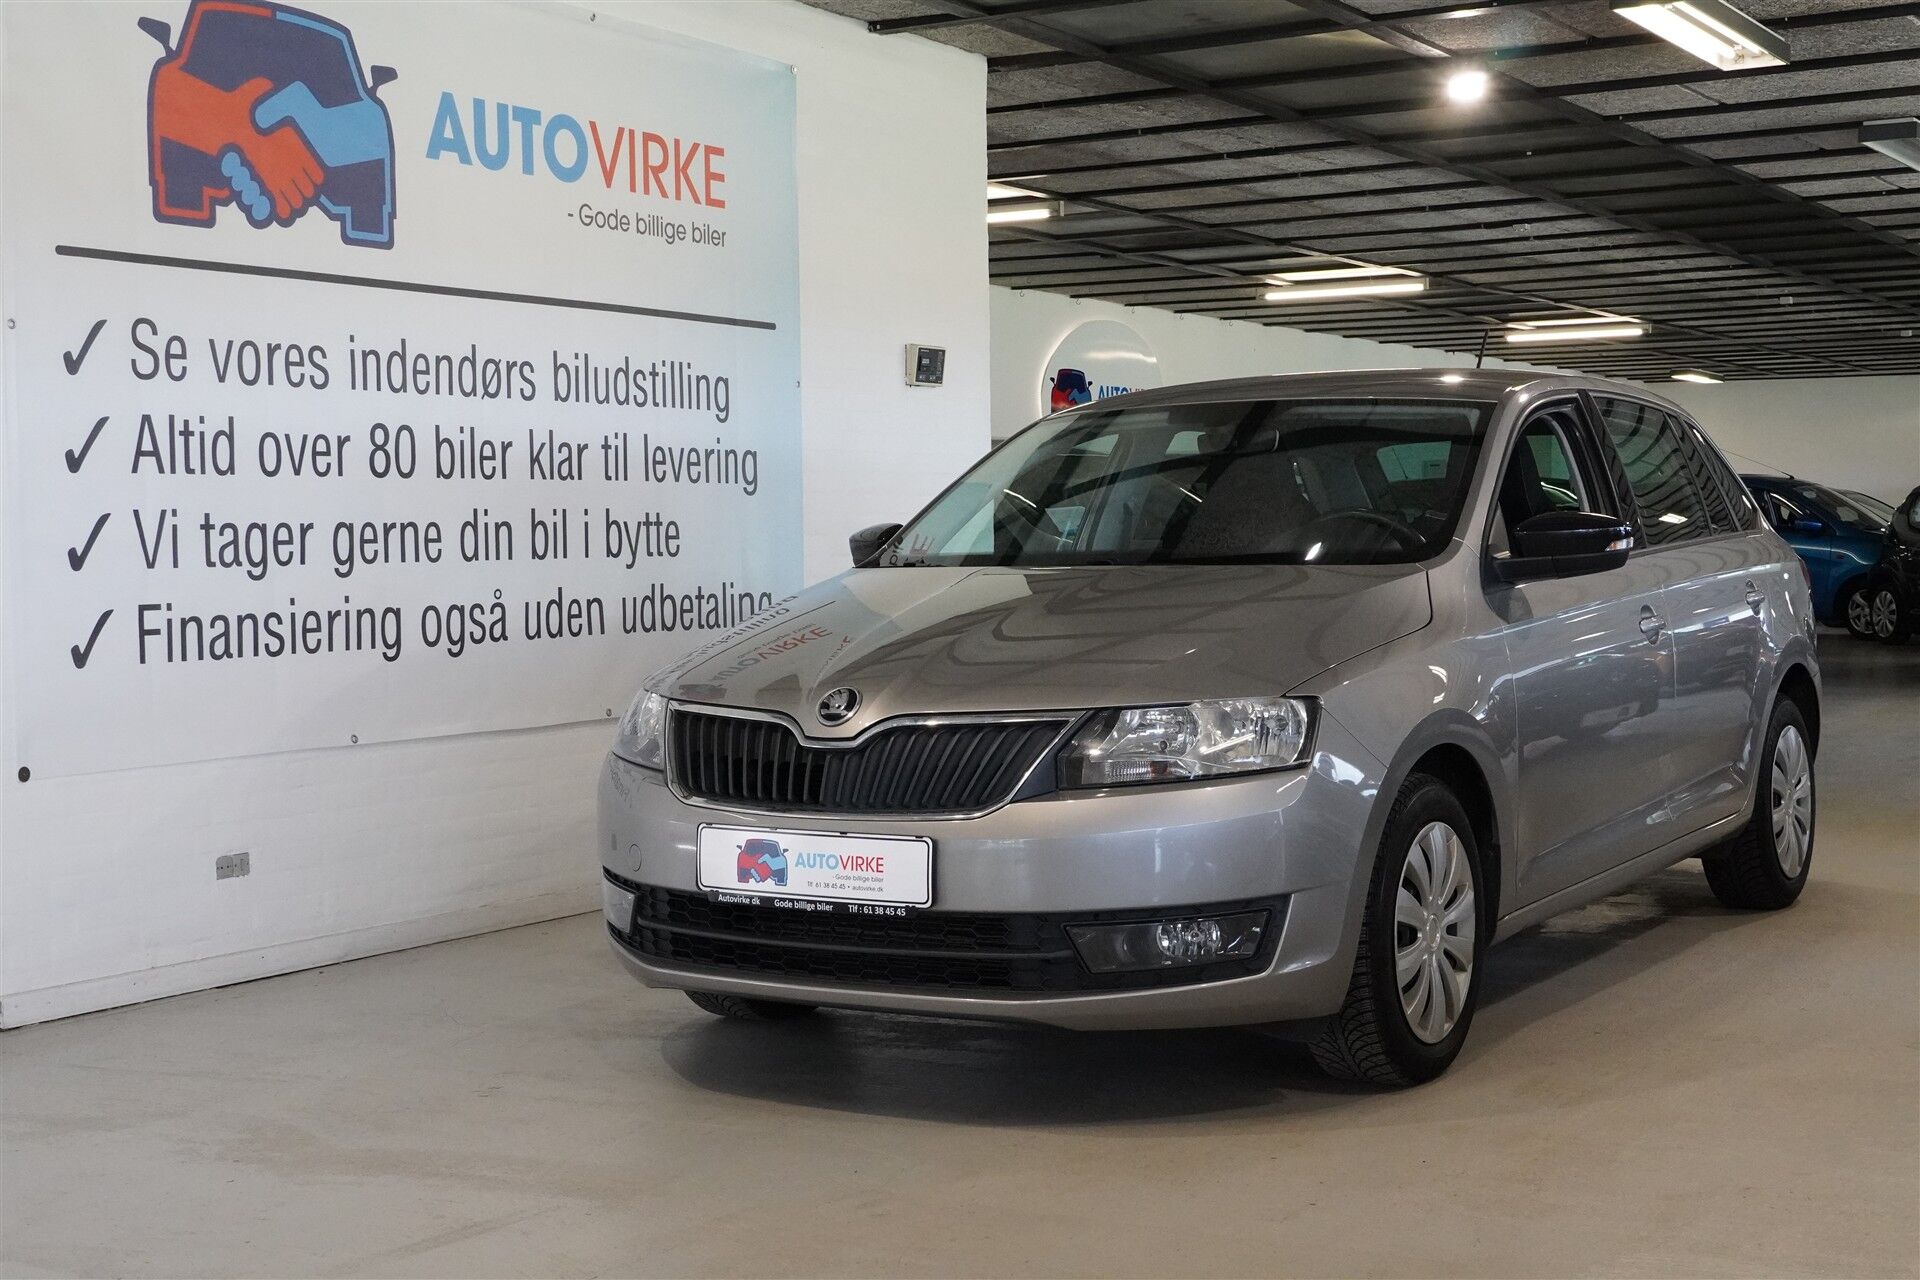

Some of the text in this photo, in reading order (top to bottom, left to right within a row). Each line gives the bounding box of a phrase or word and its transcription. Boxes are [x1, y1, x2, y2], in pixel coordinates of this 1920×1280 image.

[425, 90, 726, 210] AUTOVIRKE
[578, 203, 631, 233] Gode
[635, 211, 687, 245] billige
[691, 221, 727, 248] biler
[130, 316, 731, 424] Se vores indendørs biludstilling
[130, 413, 759, 497] Altid over 80 biler klar til levering
[132, 507, 681, 582] Vi tager gerne din bil i bytte
[137, 595, 402, 665] Finansiering
[420, 588, 509, 659] også
[524, 586, 606, 641] uden
[794, 852, 884, 873] AUTOVIRKE
[835, 873, 852, 881] Gode
[852, 875, 870, 884] billige
[717, 894, 750, 905] Autovirke
[774, 899, 793, 908] Gode
[794, 900, 816, 912] billige
[816, 902, 834, 912] biler
[848, 904, 858, 913] Tlf
[863, 905, 873, 914] 61
[874, 906, 884, 915] 38
[885, 907, 895, 916] 45
[896, 908, 906, 917] 45
